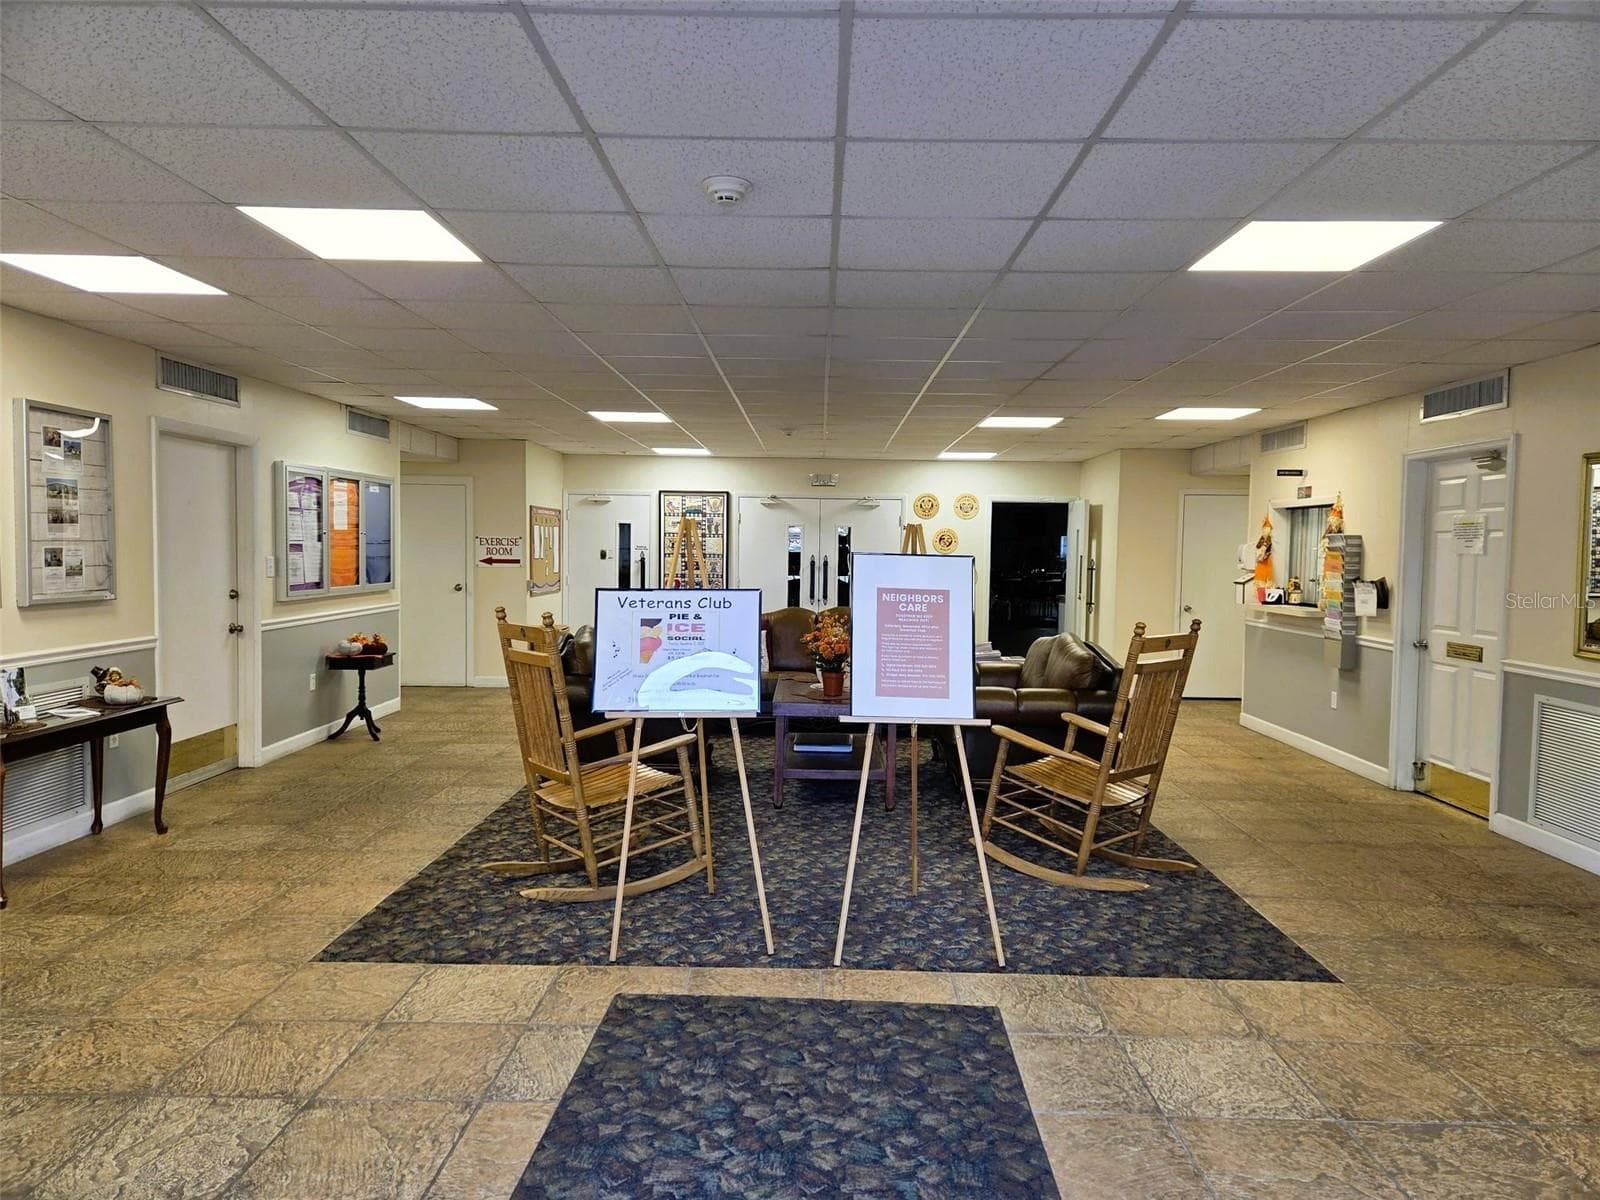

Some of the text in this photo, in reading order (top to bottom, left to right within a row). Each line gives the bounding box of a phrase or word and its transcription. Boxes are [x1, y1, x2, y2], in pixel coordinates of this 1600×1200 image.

[479, 537, 520, 546] EXERCISE
[486, 547, 513, 556] ROOM
[617, 596, 733, 609] Veterans Club
[882, 593, 944, 603] NEIGHBORS
[899, 603, 928, 612] CARE
[667, 623, 706, 633] ICE
